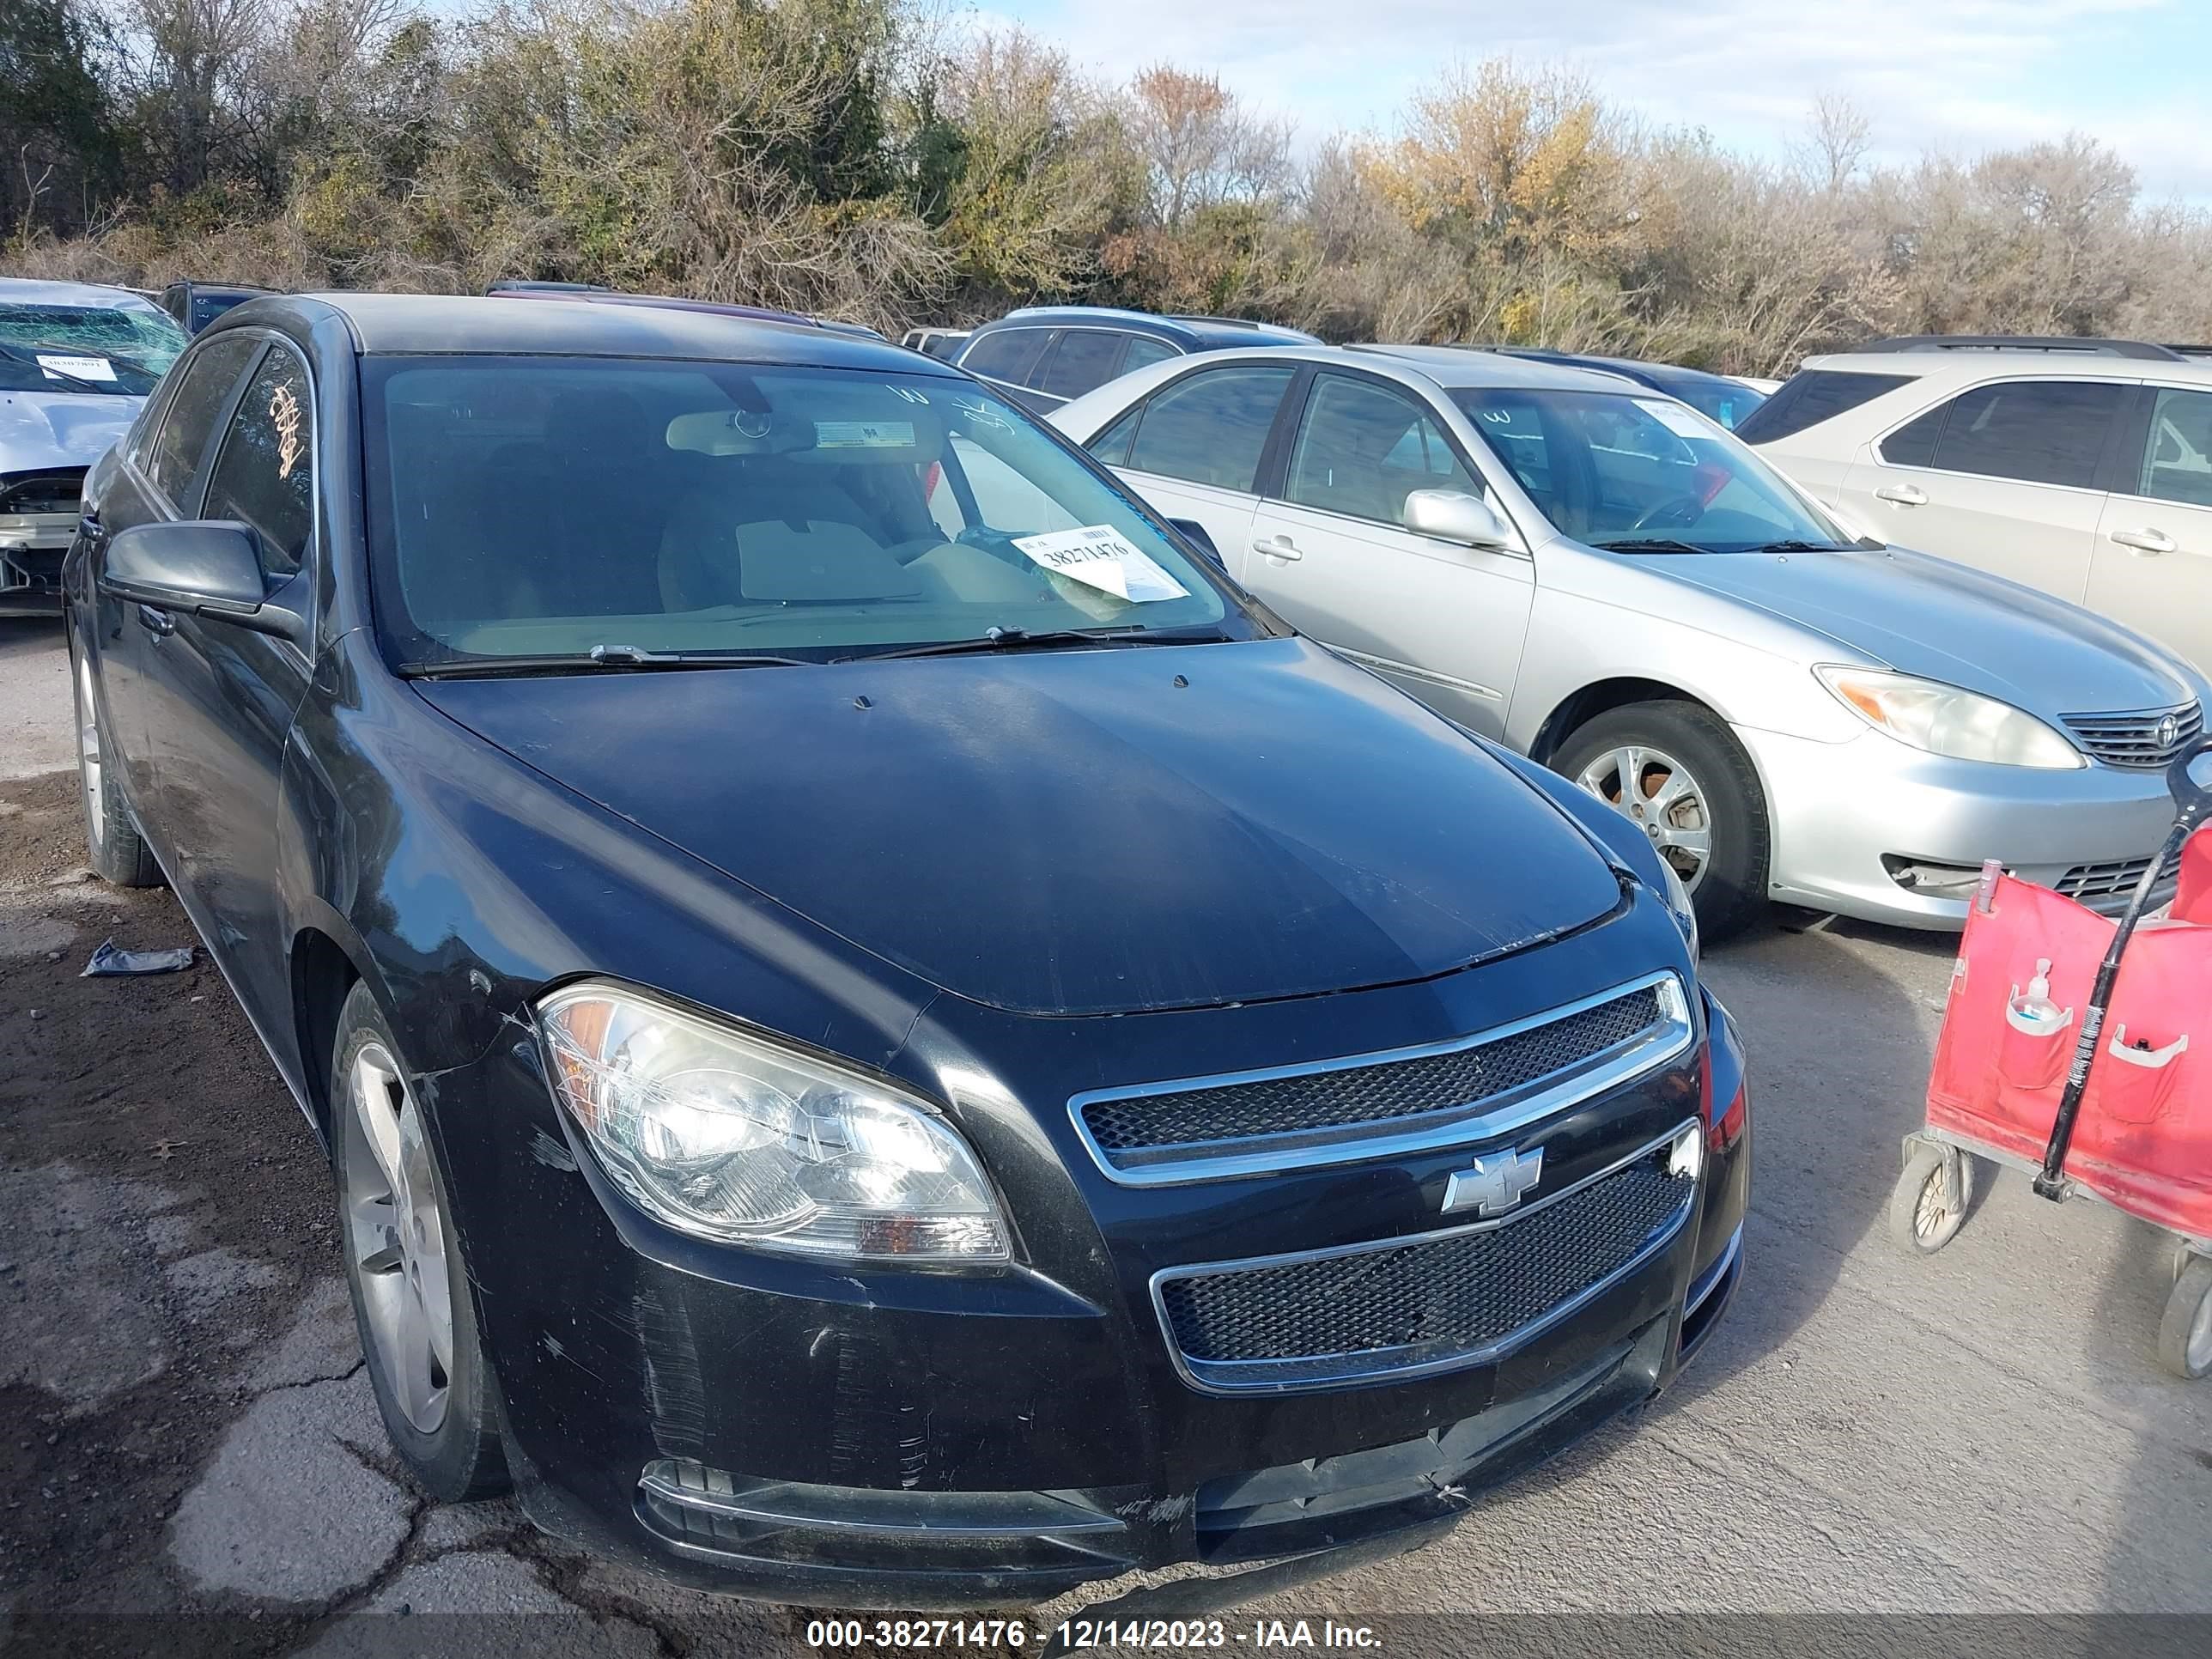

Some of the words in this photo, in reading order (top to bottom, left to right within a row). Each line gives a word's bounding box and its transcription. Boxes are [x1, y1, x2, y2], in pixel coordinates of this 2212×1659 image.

[885, 385, 930, 405] W
[1483, 410, 1511, 423] W
[1043, 542, 1129, 568] 38271476
